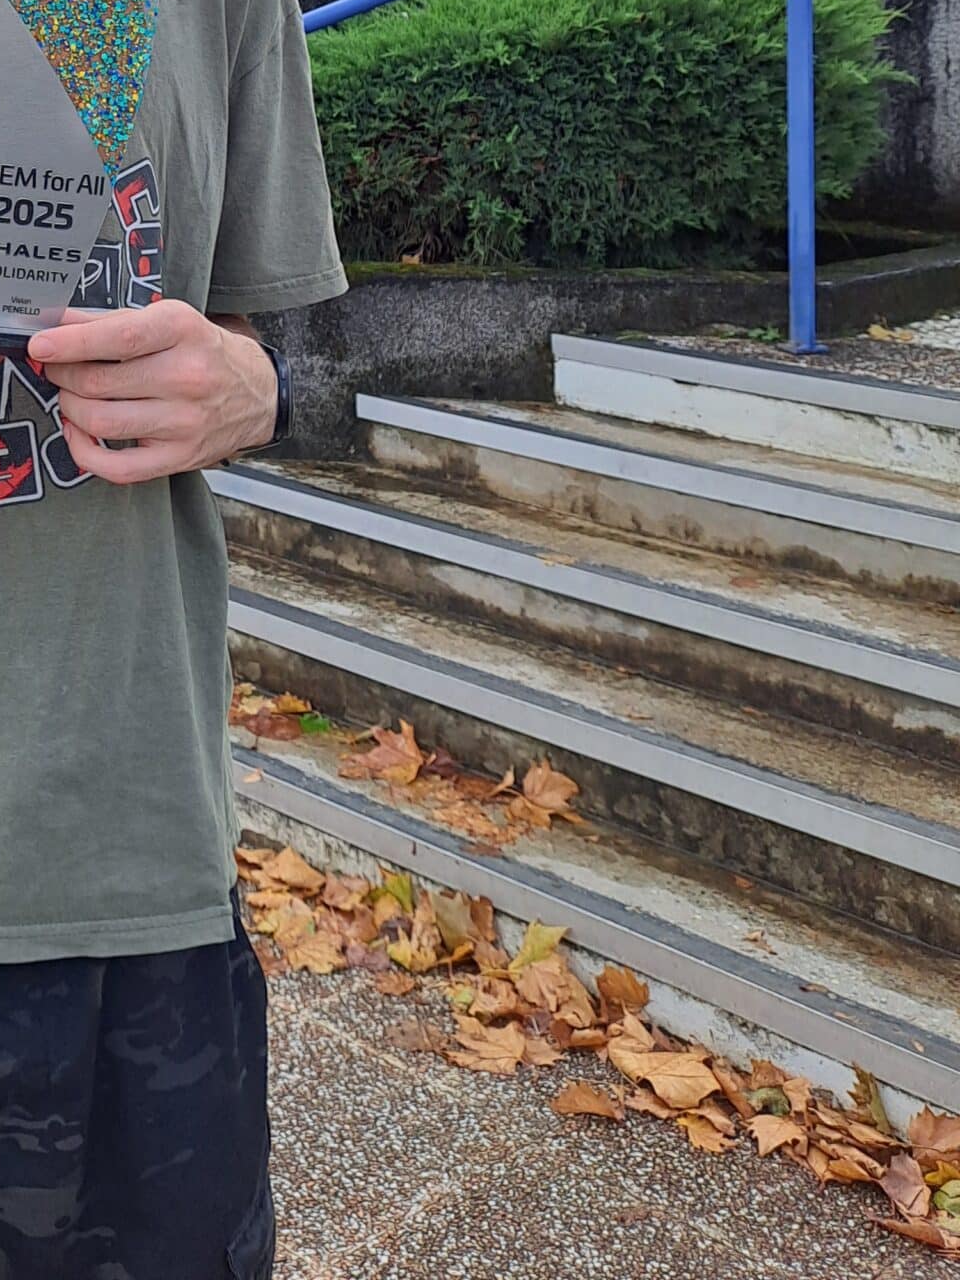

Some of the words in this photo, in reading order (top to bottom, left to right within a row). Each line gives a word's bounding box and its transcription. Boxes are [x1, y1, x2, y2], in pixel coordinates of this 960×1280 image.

[42, 169, 75, 194] for
[76, 173, 106, 197] All
[1, 304, 41, 317] PENELLO
